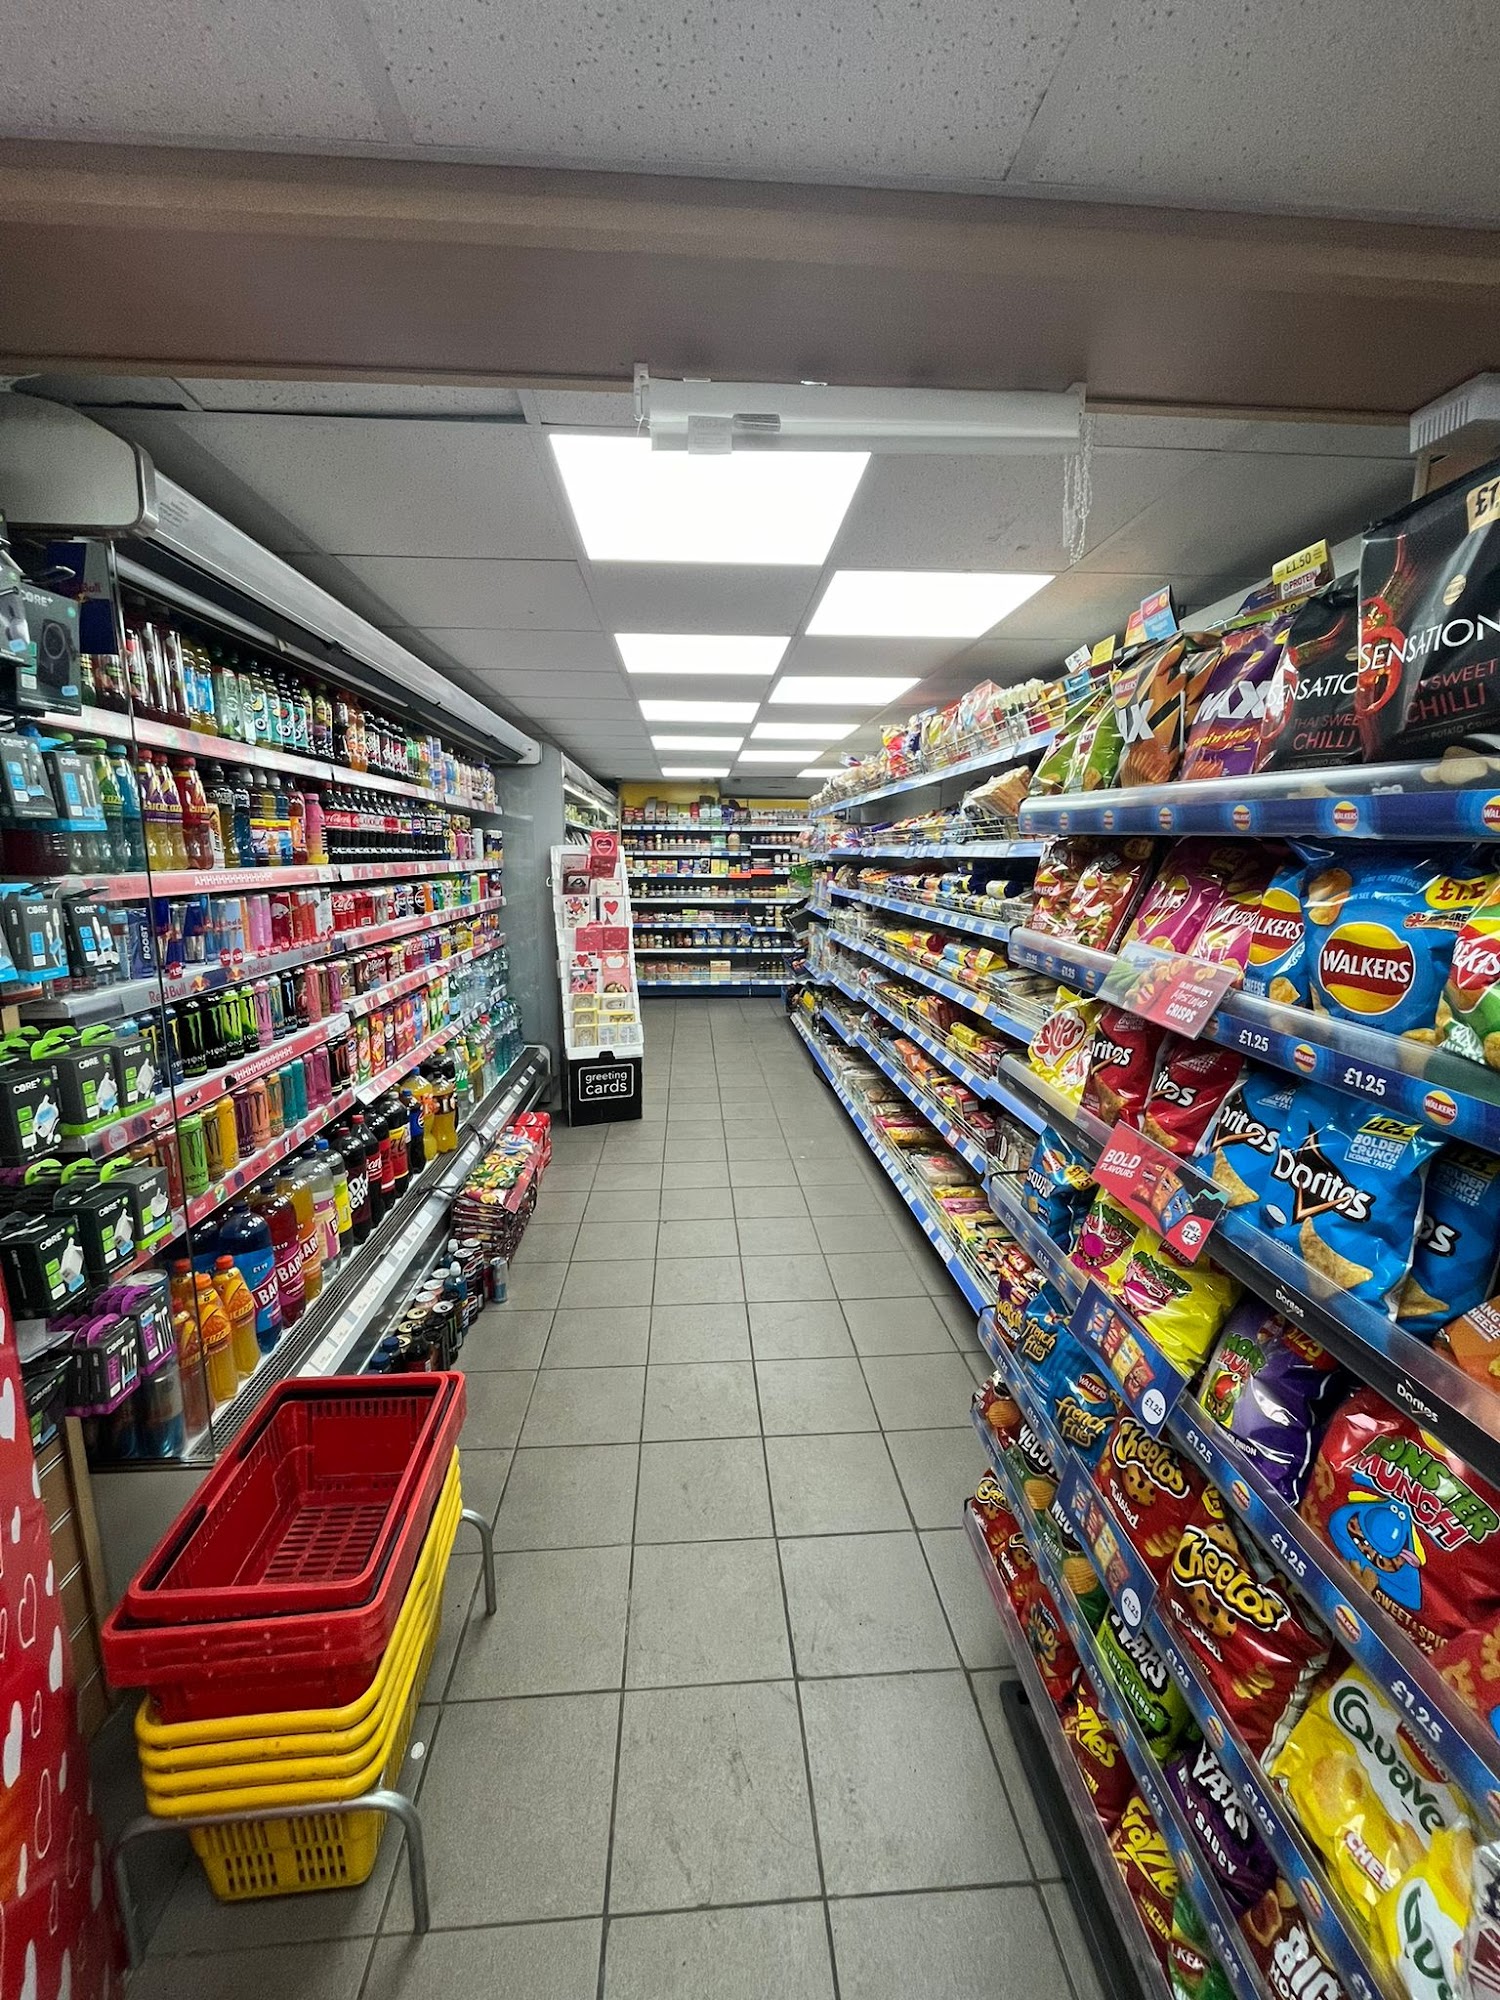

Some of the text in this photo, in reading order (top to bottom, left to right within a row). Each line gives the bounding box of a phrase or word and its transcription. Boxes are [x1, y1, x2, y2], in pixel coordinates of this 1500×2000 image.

[1285, 552, 1312, 575] £1.50
[1431, 658, 1499, 690] SWEET
[1406, 682, 1487, 723] CHILLI
[1293, 730, 1355, 751] CHILLI
[1333, 810, 1359, 821] WALKERS
[26, 905, 49, 915] CORE
[140, 925, 151, 960] BOOST
[1061, 966, 1076, 980] £1.25
[1322, 949, 1414, 984] WALKERS
[1242, 977, 1266, 998] CHEESE
[1165, 1002, 1198, 1024] CRISPS
[124, 1045, 142, 1057] CORE
[1238, 1029, 1270, 1052] £1.25
[78, 1057, 99, 1070] CORE
[1293, 1050, 1317, 1065] WALKERS
[585, 1070, 628, 1085] greeting
[585, 1080, 628, 1096] cards
[1343, 1067, 1388, 1097] £1.25
[1423, 1098, 1457, 1117] WALKERS
[1349, 1143, 1400, 1164] CRUNCH
[1353, 1133, 1405, 1155] BOLDER
[1099, 1163, 1136, 1180] FLAVOURS
[1103, 1149, 1142, 1169] BOLD
[138, 1176, 157, 1193] CORE
[1067, 1166, 1093, 1187] £1.25
[1273, 1147, 1373, 1221] Doritos
[39, 1227, 66, 1251] CORE+
[1182, 1229, 1201, 1243] £1.25
[1036, 1250, 1050, 1266] £1.25
[1275, 1287, 1304, 1318] Doritos
[106, 1335, 125, 1354] CORE
[1022, 1317, 1058, 1349] french
[1022, 1337, 1050, 1362] fries
[1077, 1374, 1108, 1400] WALKERS
[1143, 1397, 1164, 1417] £1.25
[1396, 1381, 1439, 1424] Doritos
[1026, 1405, 1041, 1428] £1.25
[1055, 1396, 1116, 1435] french
[1061, 1418, 1097, 1448] fries
[1115, 1419, 1186, 1493] Cheetos
[1186, 1429, 1214, 1464] £1.25
[1109, 1478, 1139, 1530] Twisted
[1349, 1452, 1470, 1549] MUNCH
[1270, 1532, 1307, 1578] £1.25
[1173, 1529, 1284, 1626] Cheetos
[1123, 1596, 1140, 1619] £1.25
[1375, 1589, 1411, 1625] SWEET
[1089, 1664, 1107, 1698] £1.25
[1166, 1648, 1191, 1689] £1.25
[1390, 1679, 1444, 1743] £1.25
[1141, 1774, 1165, 1817] £1.25
[1243, 1783, 1277, 1836] £1.25
[1194, 1811, 1238, 1876] SAUCY
[1210, 1923, 1240, 1979] £1.25
[1273, 1925, 1339, 2000] BIG
